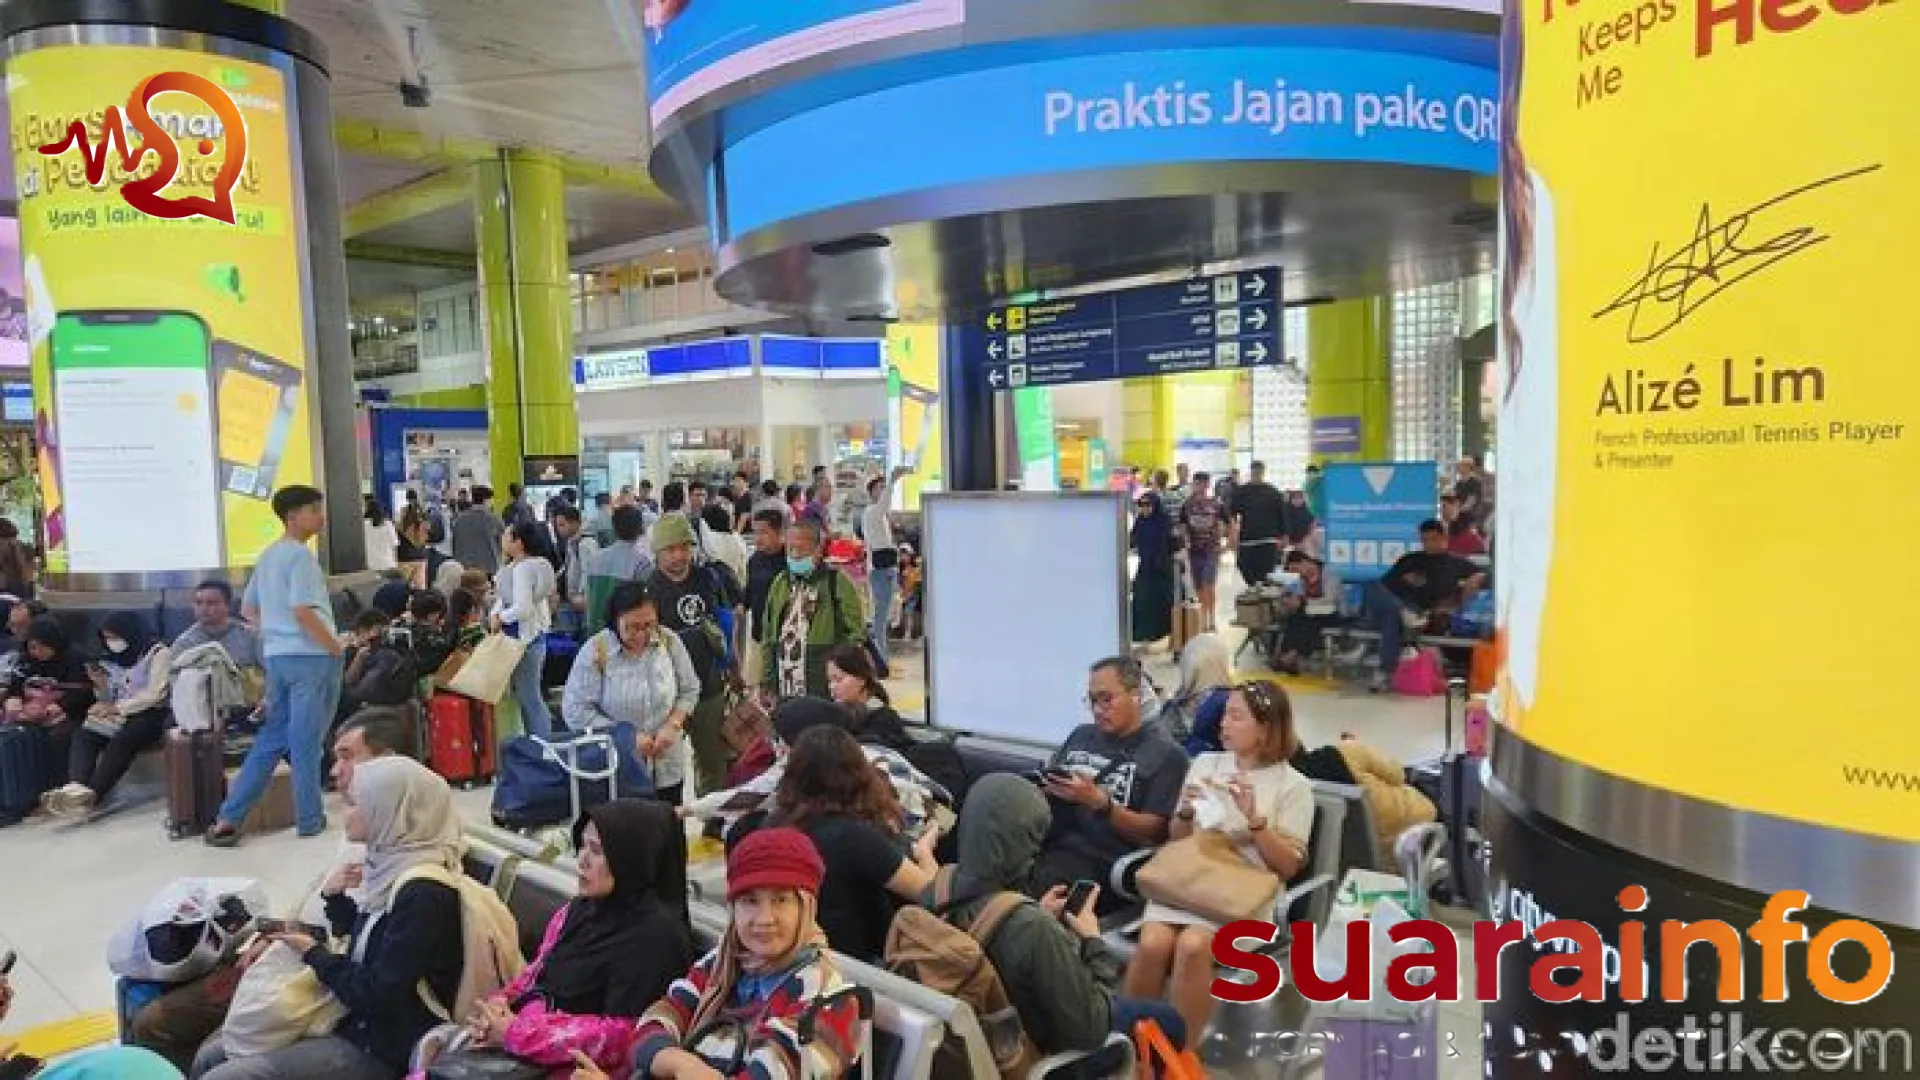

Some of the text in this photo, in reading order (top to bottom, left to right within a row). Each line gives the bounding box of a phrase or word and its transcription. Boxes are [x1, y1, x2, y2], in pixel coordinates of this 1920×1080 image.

[1578, 0, 1676, 60] Keeps
[1044, 79, 1211, 135] Praktis
[1222, 79, 1341, 135] Jajan
[1355, 82, 1447, 137] pake
[1576, 65, 1622, 109] Me
[1596, 355, 1825, 416] Alizé Lim
[1642, 426, 1746, 445] Professional
[1754, 423, 1819, 442] Tennis
[1828, 421, 1905, 444] Player
